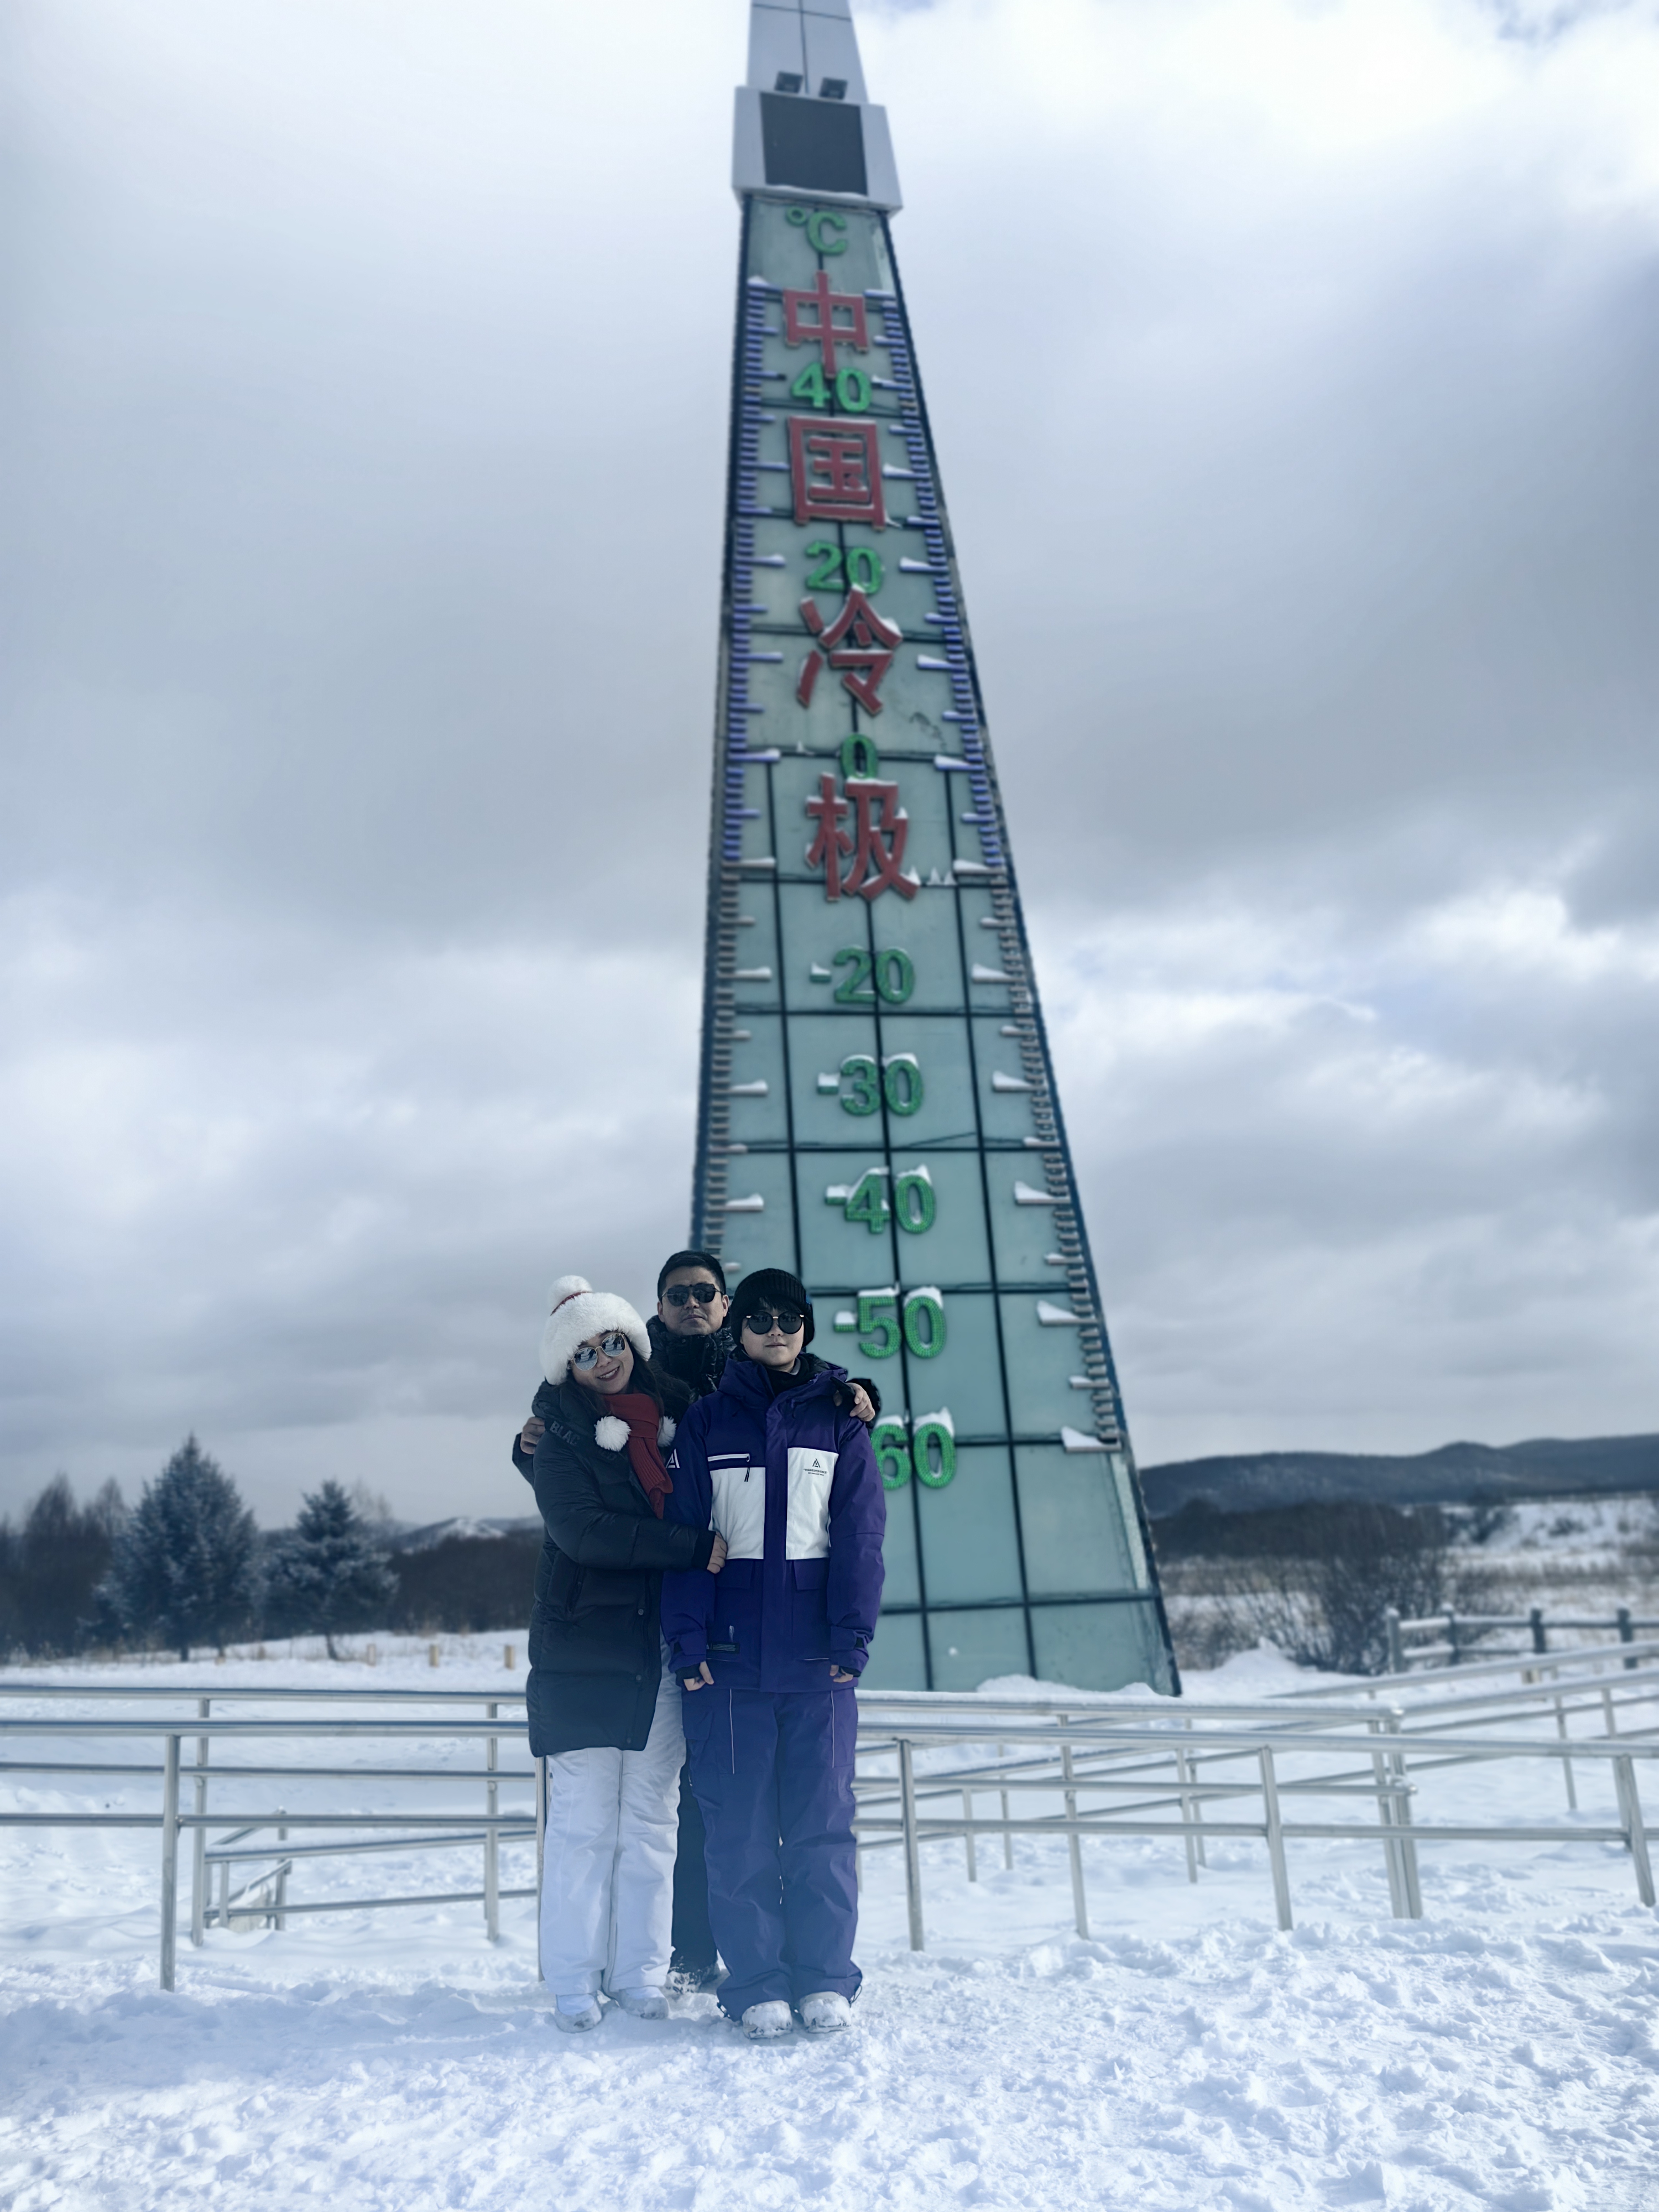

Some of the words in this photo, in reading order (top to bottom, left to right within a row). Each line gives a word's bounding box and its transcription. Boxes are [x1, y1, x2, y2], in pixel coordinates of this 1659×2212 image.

[790, 361, 872, 412] 40
[782, 270, 921, 902] 中国冷极
[806, 541, 882, 595] 20
[841, 734, 878, 780] 0
[810, 946, 915, 1004] -20
[817, 1057, 924, 1117] -30
[825, 1171, 936, 1234] -40
[833, 1293, 946, 1359] -50
